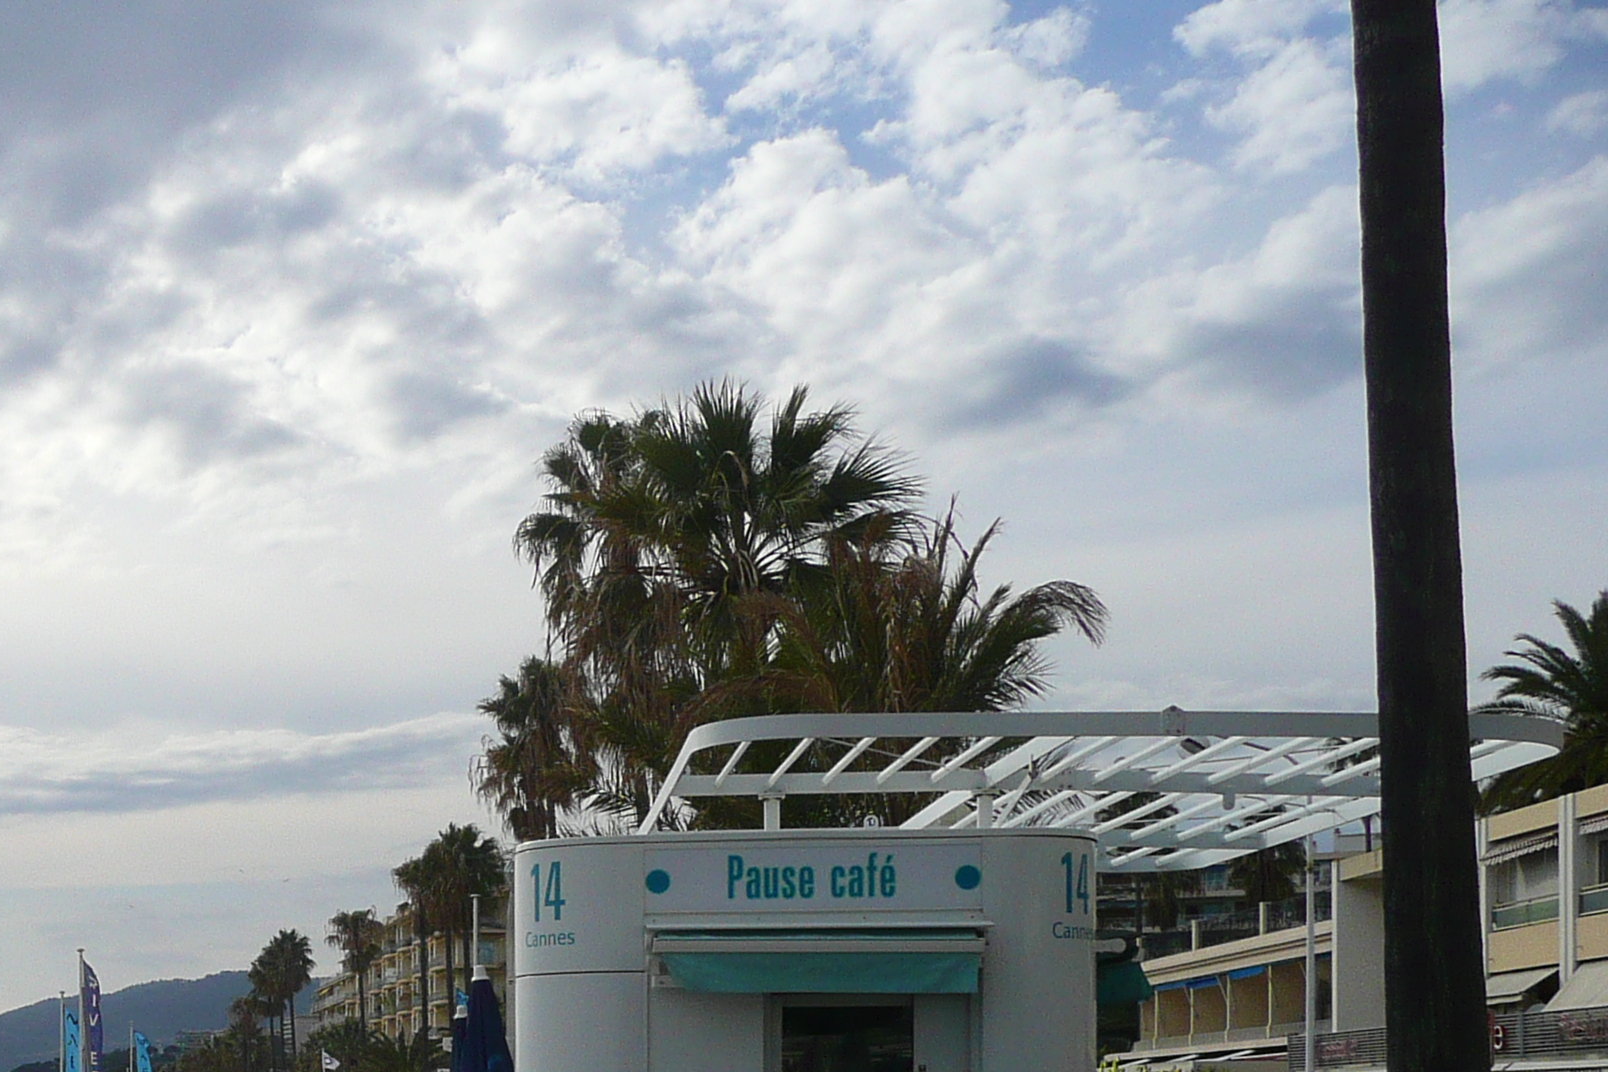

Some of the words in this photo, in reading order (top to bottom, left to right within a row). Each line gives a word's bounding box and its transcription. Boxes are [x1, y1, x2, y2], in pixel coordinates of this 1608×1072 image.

[530, 861, 566, 922] 14
[727, 855, 814, 899] Pause
[831, 853, 896, 898] café
[1061, 852, 1089, 914] 14
[525, 931, 575, 948] Cannes
